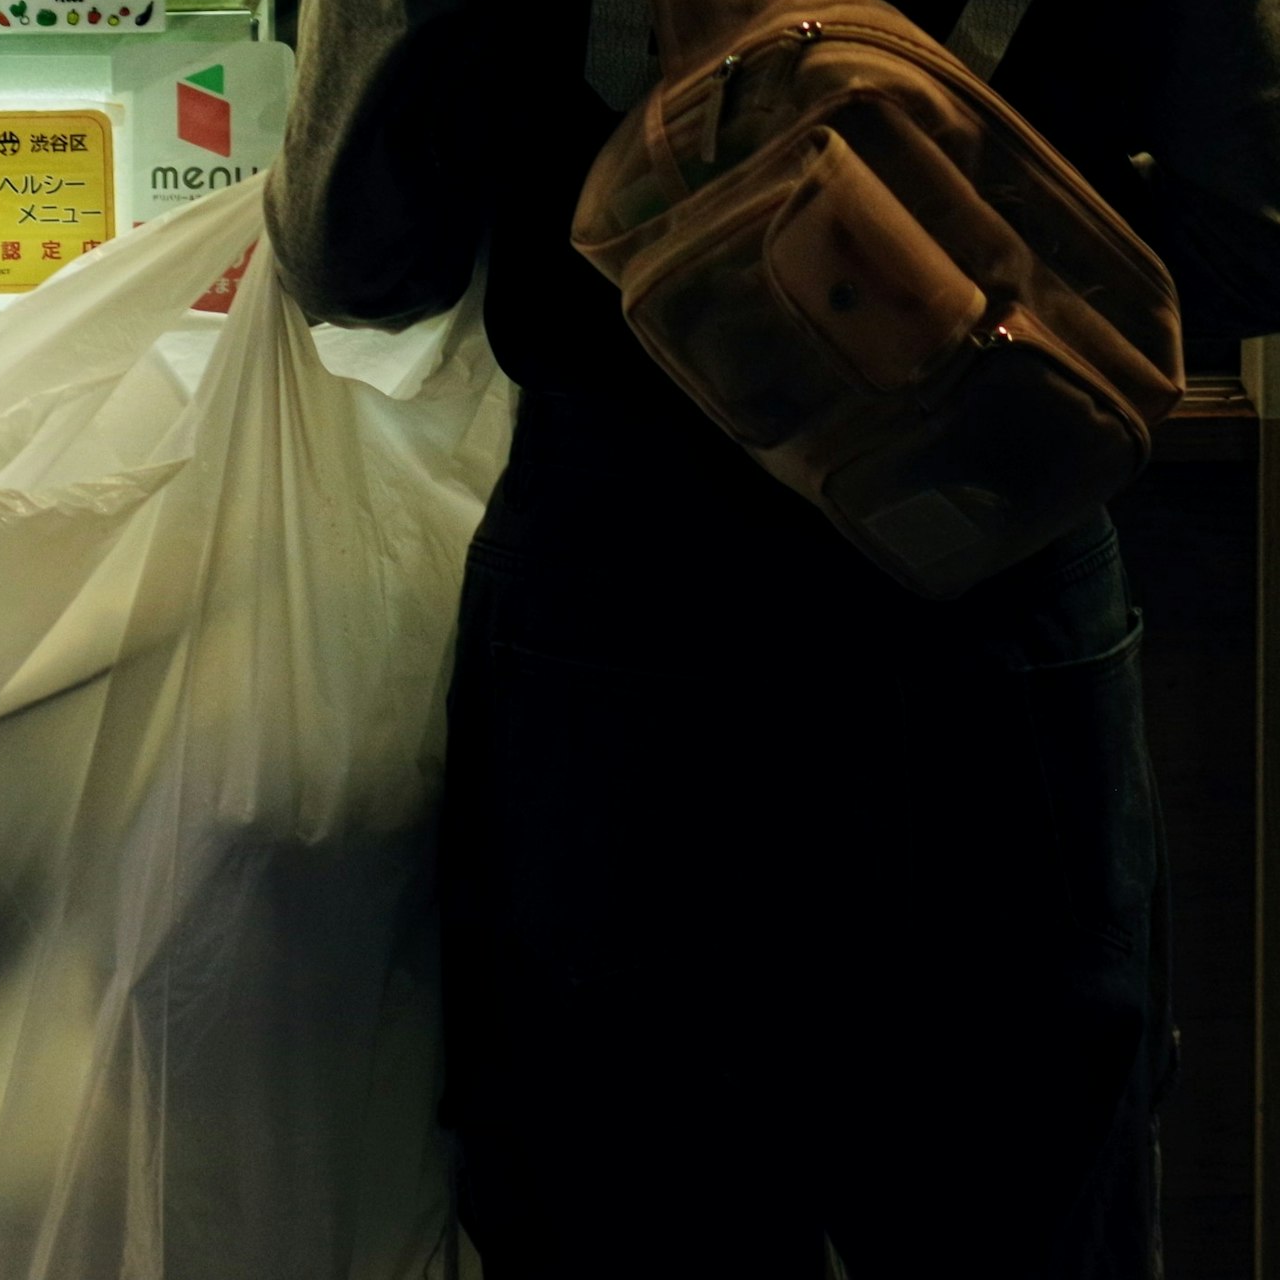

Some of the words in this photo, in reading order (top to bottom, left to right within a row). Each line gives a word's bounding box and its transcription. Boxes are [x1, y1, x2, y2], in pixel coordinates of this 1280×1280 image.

[29, 131, 90, 155] 渋谷区
[17, 203, 104, 225] メニュー
